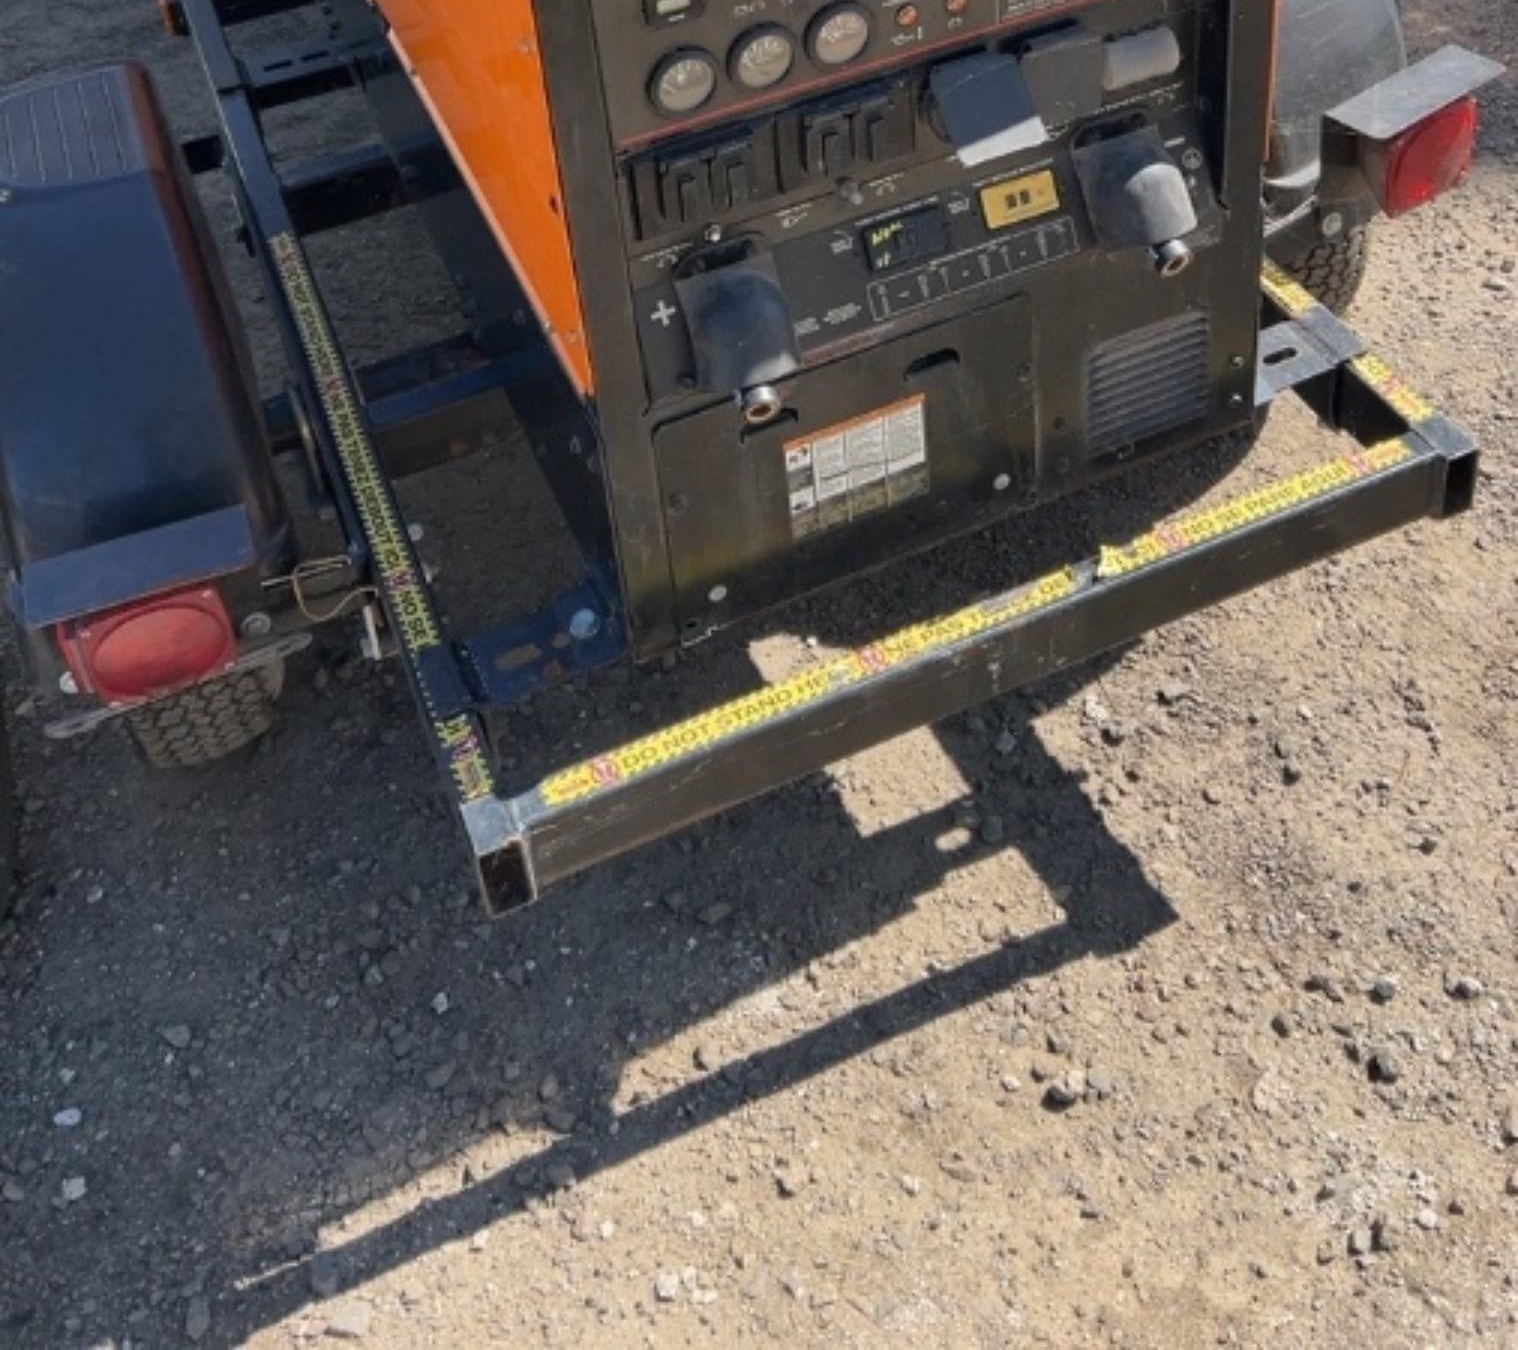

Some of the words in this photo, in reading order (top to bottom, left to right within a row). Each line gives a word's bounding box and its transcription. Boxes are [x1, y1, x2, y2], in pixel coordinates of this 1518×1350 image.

[621, 746, 658, 770] DO
[662, 724, 710, 751] NOT
[716, 687, 792, 729] STAND
